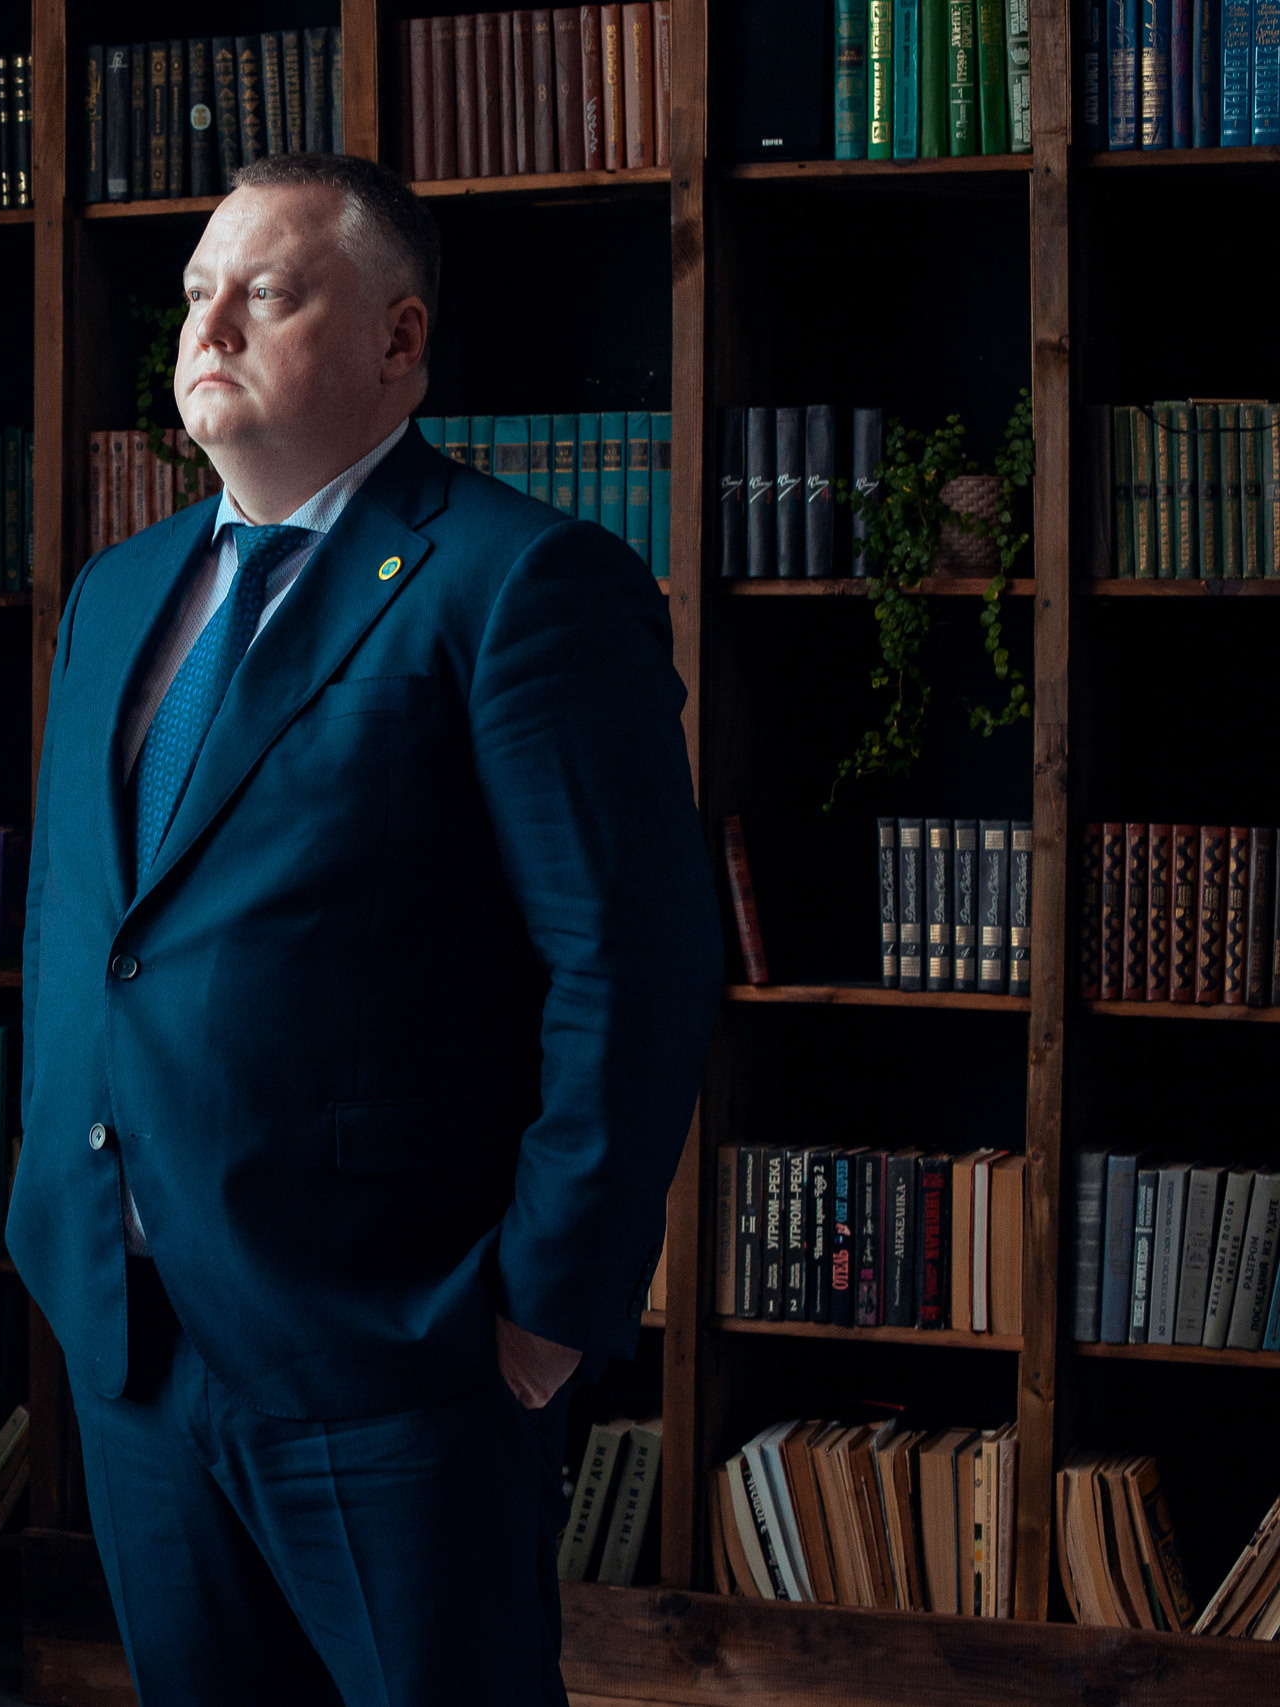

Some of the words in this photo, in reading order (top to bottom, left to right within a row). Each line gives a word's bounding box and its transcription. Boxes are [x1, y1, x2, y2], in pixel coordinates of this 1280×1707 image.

[956, 49, 968, 82] ГРАФ
[766, 1157, 781, 1250] УГРЮМ-РЕКА
[788, 1156, 803, 1250] УГРЮМ-РЕКА
[894, 1183, 907, 1259] АНЖЕЛИКА
[1264, 1198, 1280, 1235] УДЭГЕ
[832, 1249, 849, 1290] ОТЕЛЬ
[1209, 1245, 1228, 1317] ЖЕЛЕЗНЫЙ
[1221, 1199, 1235, 1241] ПОТОК
[1225, 1234, 1241, 1284] ЧАПАЕВ
[1242, 1235, 1260, 1291] РАЗГРОМ
[1261, 1239, 1273, 1258] ИЗ
[1250, 1260, 1270, 1332] ПОСЛЕДНИЙ
[573, 1487, 597, 1545] ТИХИЙ
[590, 1445, 607, 1481] ДОН
[619, 1487, 640, 1544] ТИХИЙ
[634, 1446, 649, 1482] ДОН
